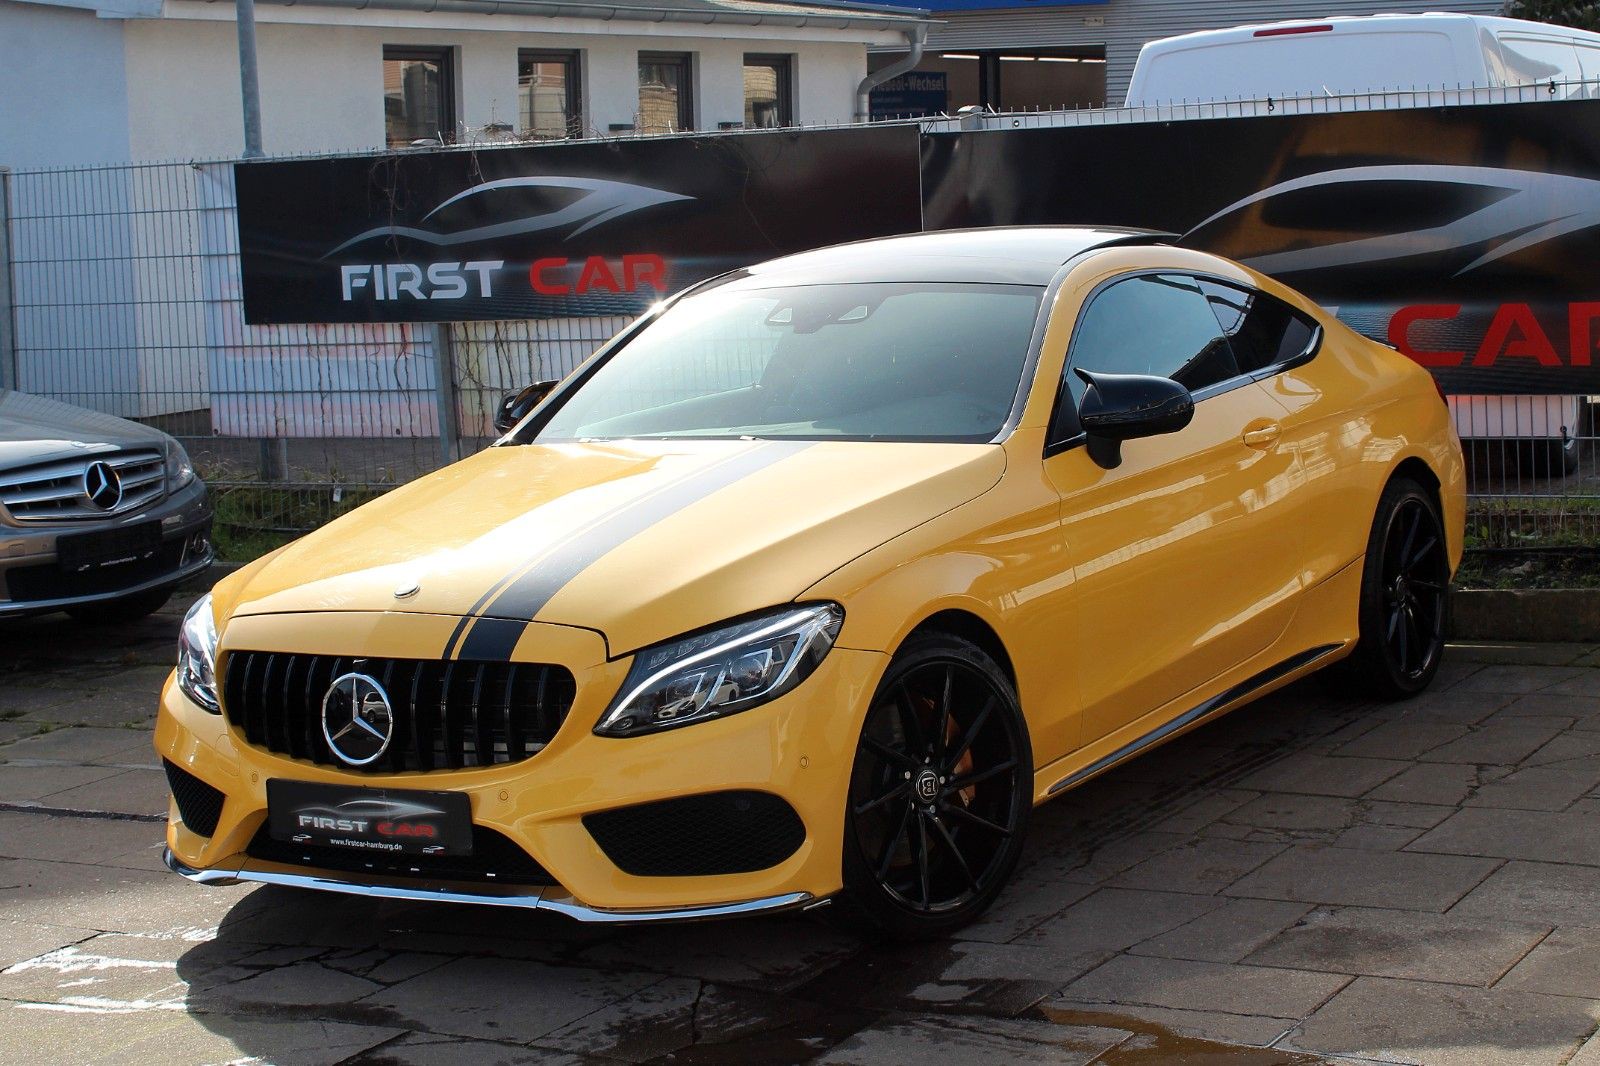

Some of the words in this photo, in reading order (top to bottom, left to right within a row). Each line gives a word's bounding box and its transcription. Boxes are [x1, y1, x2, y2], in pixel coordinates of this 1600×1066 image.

[341, 260, 504, 301] FIRST
[529, 253, 669, 296] CAR
[298, 815, 368, 833] FIRST
[376, 822, 434, 838] CAR
[330, 838, 403, 851] www.firstcar-hamburg.de
